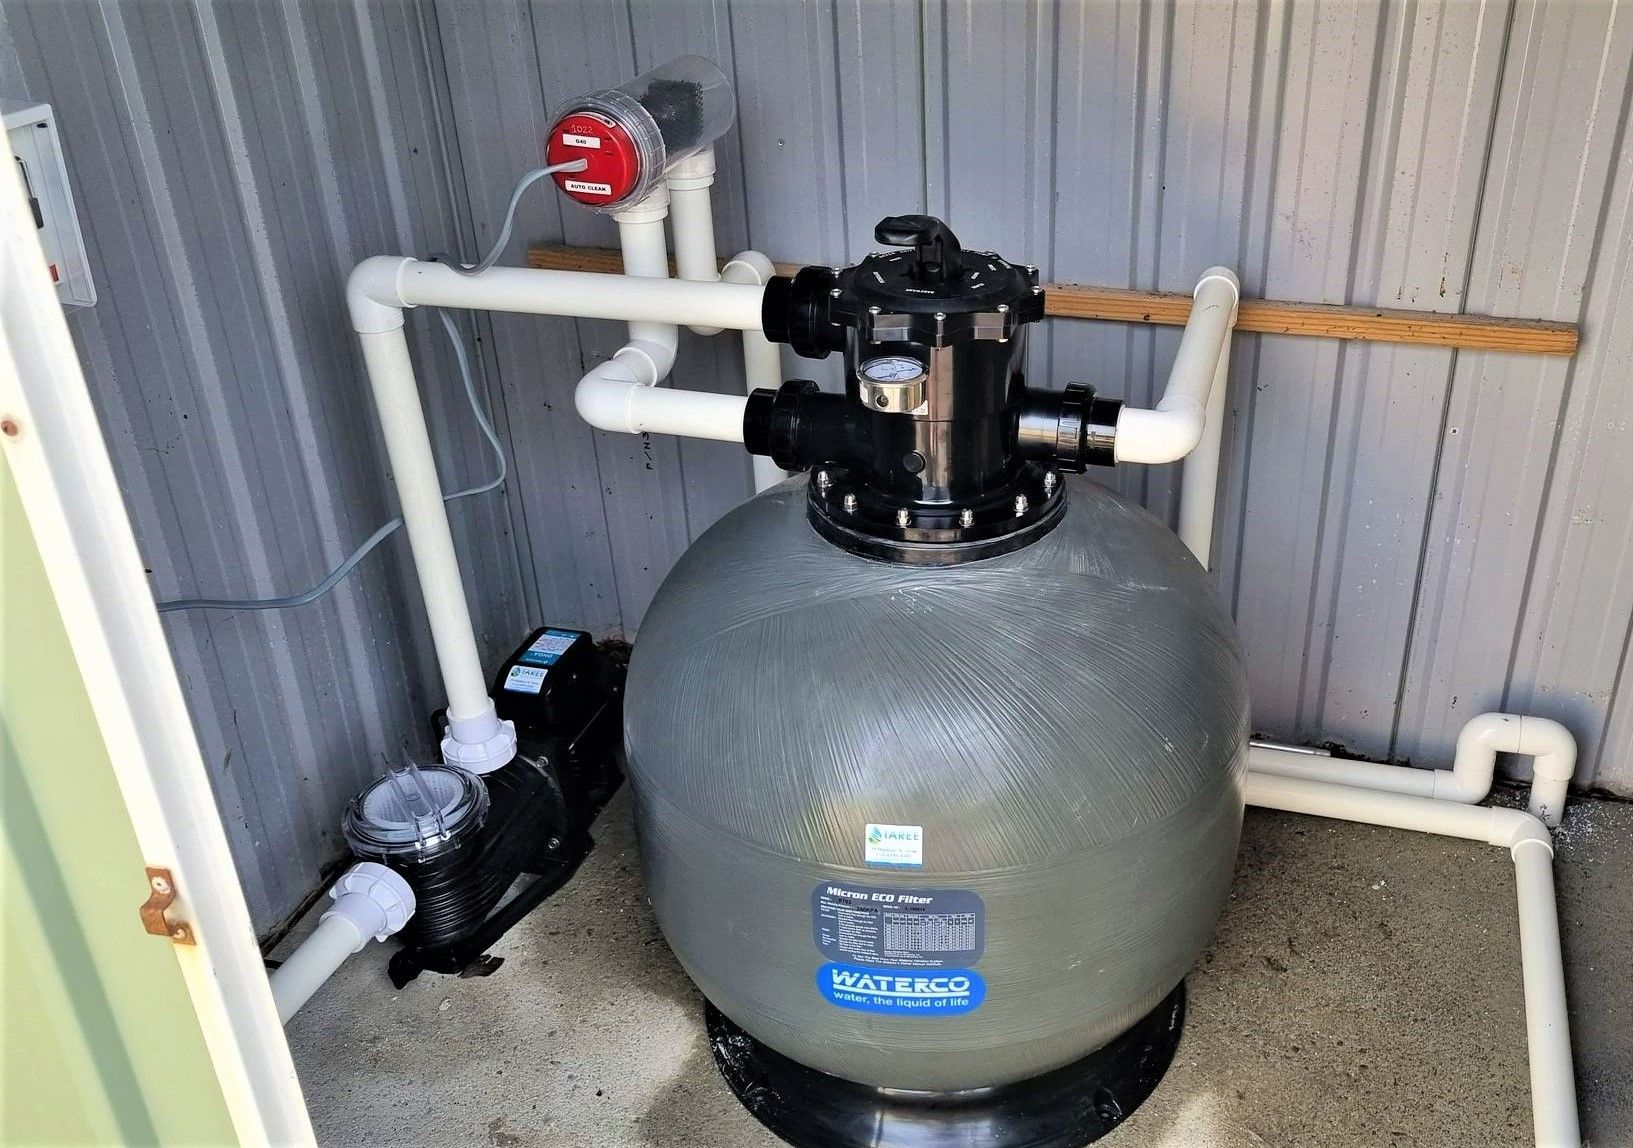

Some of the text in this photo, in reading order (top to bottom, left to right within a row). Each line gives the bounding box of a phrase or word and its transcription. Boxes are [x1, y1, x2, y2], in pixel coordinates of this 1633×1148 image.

[571, 124, 594, 134] 1022
[884, 830, 920, 841] TAREE
[827, 886, 868, 900] Micron
[872, 893, 895, 902] ECO
[898, 895, 933, 904] Filter
[832, 968, 970, 992] WATERCO
[833, 991, 969, 1009] water, the liquid of life
